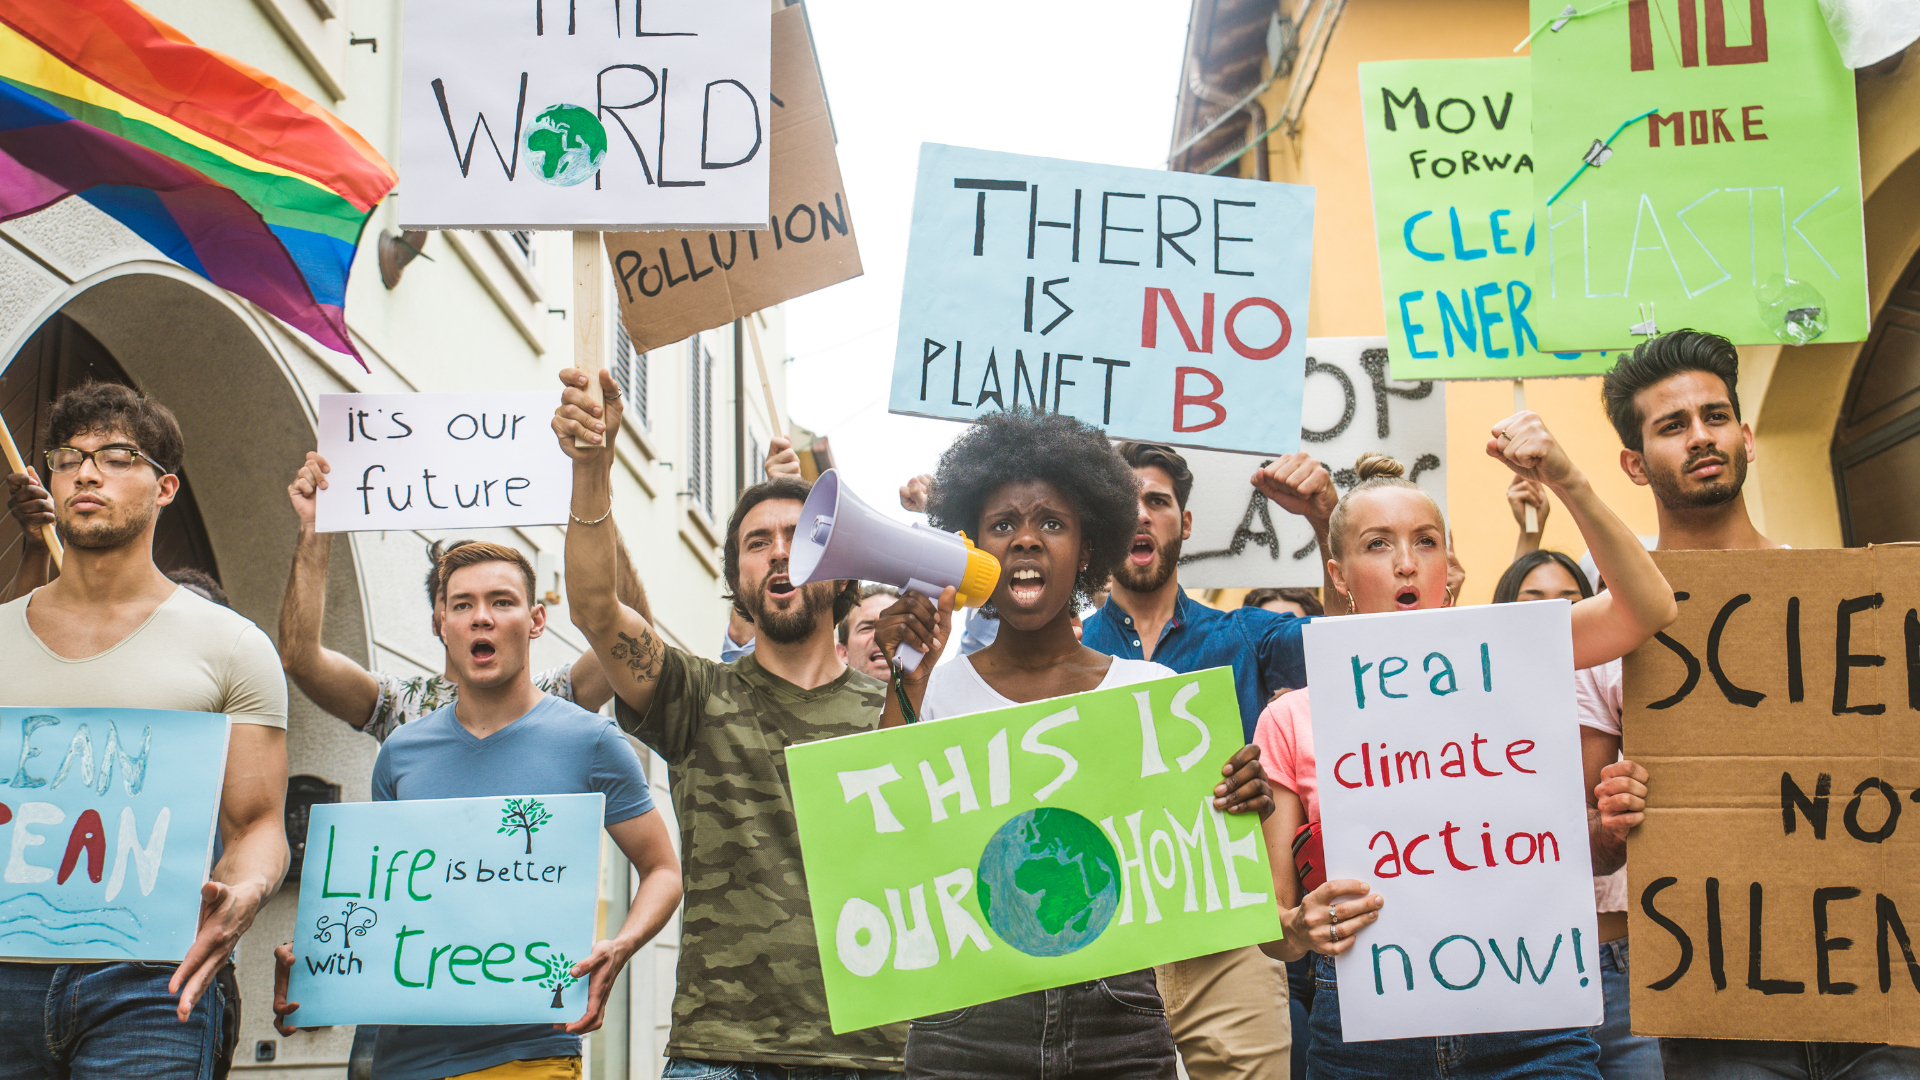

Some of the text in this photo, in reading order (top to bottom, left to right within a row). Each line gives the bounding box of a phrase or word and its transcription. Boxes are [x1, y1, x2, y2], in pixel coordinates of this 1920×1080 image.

[1628, 0, 1768, 72] NO
[1381, 86, 1533, 134] MOV
[1647, 105, 1769, 148] MORE
[1409, 149, 1534, 179] FORWA
[953, 177, 1256, 276] THERE
[1023, 276, 1292, 361] IS NO
[1399, 280, 1607, 360] ENER
[920, 337, 1227, 433] PLANET B
[348, 407, 526, 442] it's our
[357, 464, 530, 515] future
[1350, 642, 1492, 709] real
[0, 714, 152, 798] EAN
[837, 680, 1212, 833] THIS IS
[1333, 732, 1538, 790] climate
[1781, 771, 1920, 843] NO
[0, 801, 171, 903] EAN
[321, 824, 568, 902] Life is better
[836, 794, 1268, 978] OUR HOME
[1368, 821, 1561, 879] action
[305, 924, 552, 990] with trees
[1371, 927, 1590, 996] now!
[1641, 876, 1920, 996] SILEN
